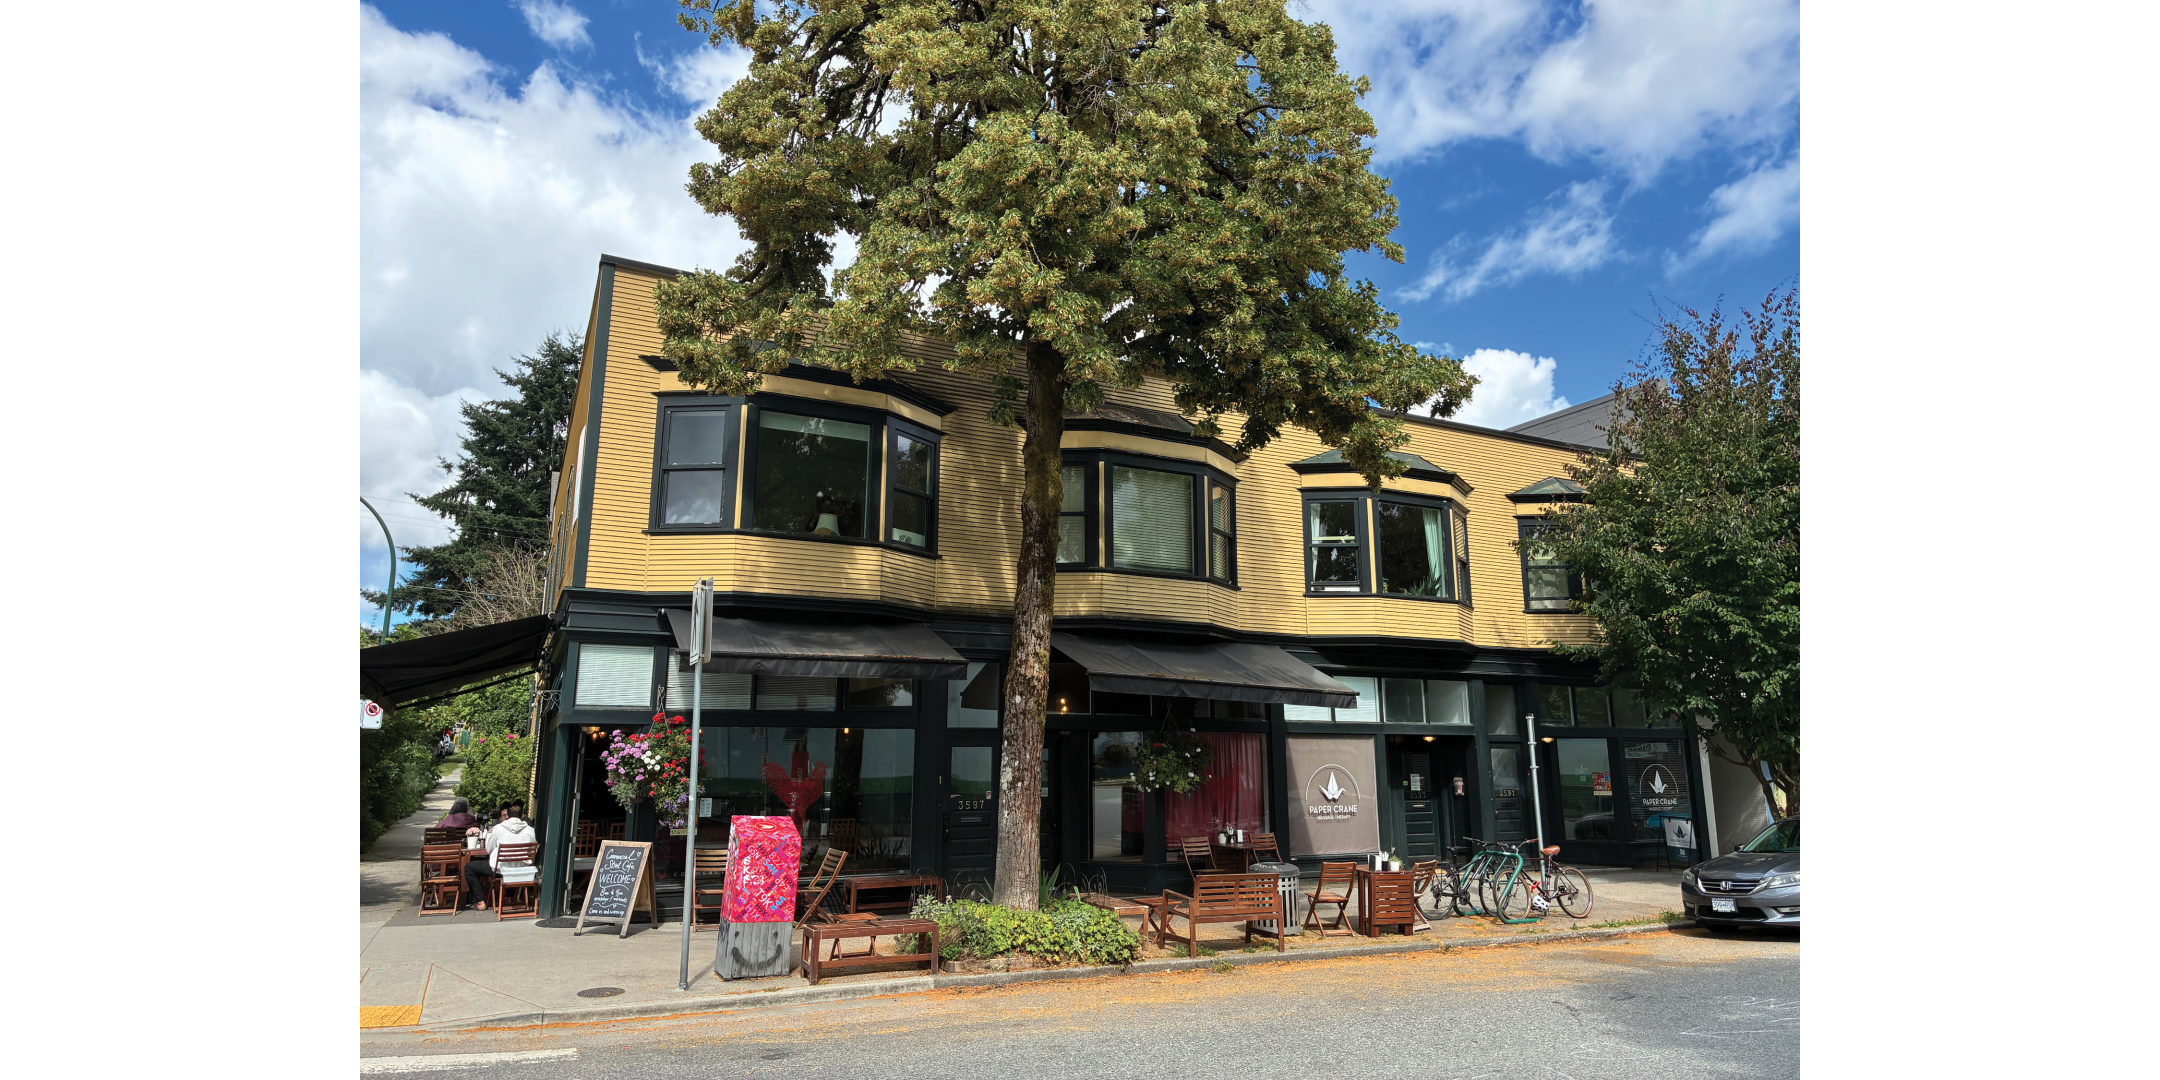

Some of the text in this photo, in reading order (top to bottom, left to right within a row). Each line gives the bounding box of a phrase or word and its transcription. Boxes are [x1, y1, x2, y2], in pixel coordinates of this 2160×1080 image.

[958, 800, 984, 810] 3597
[1310, 805, 1358, 813] PAPER CRANE
[763, 859, 777, 873] S4N
[600, 874, 631, 884] WELCOME
[754, 889, 772, 907] T9K
